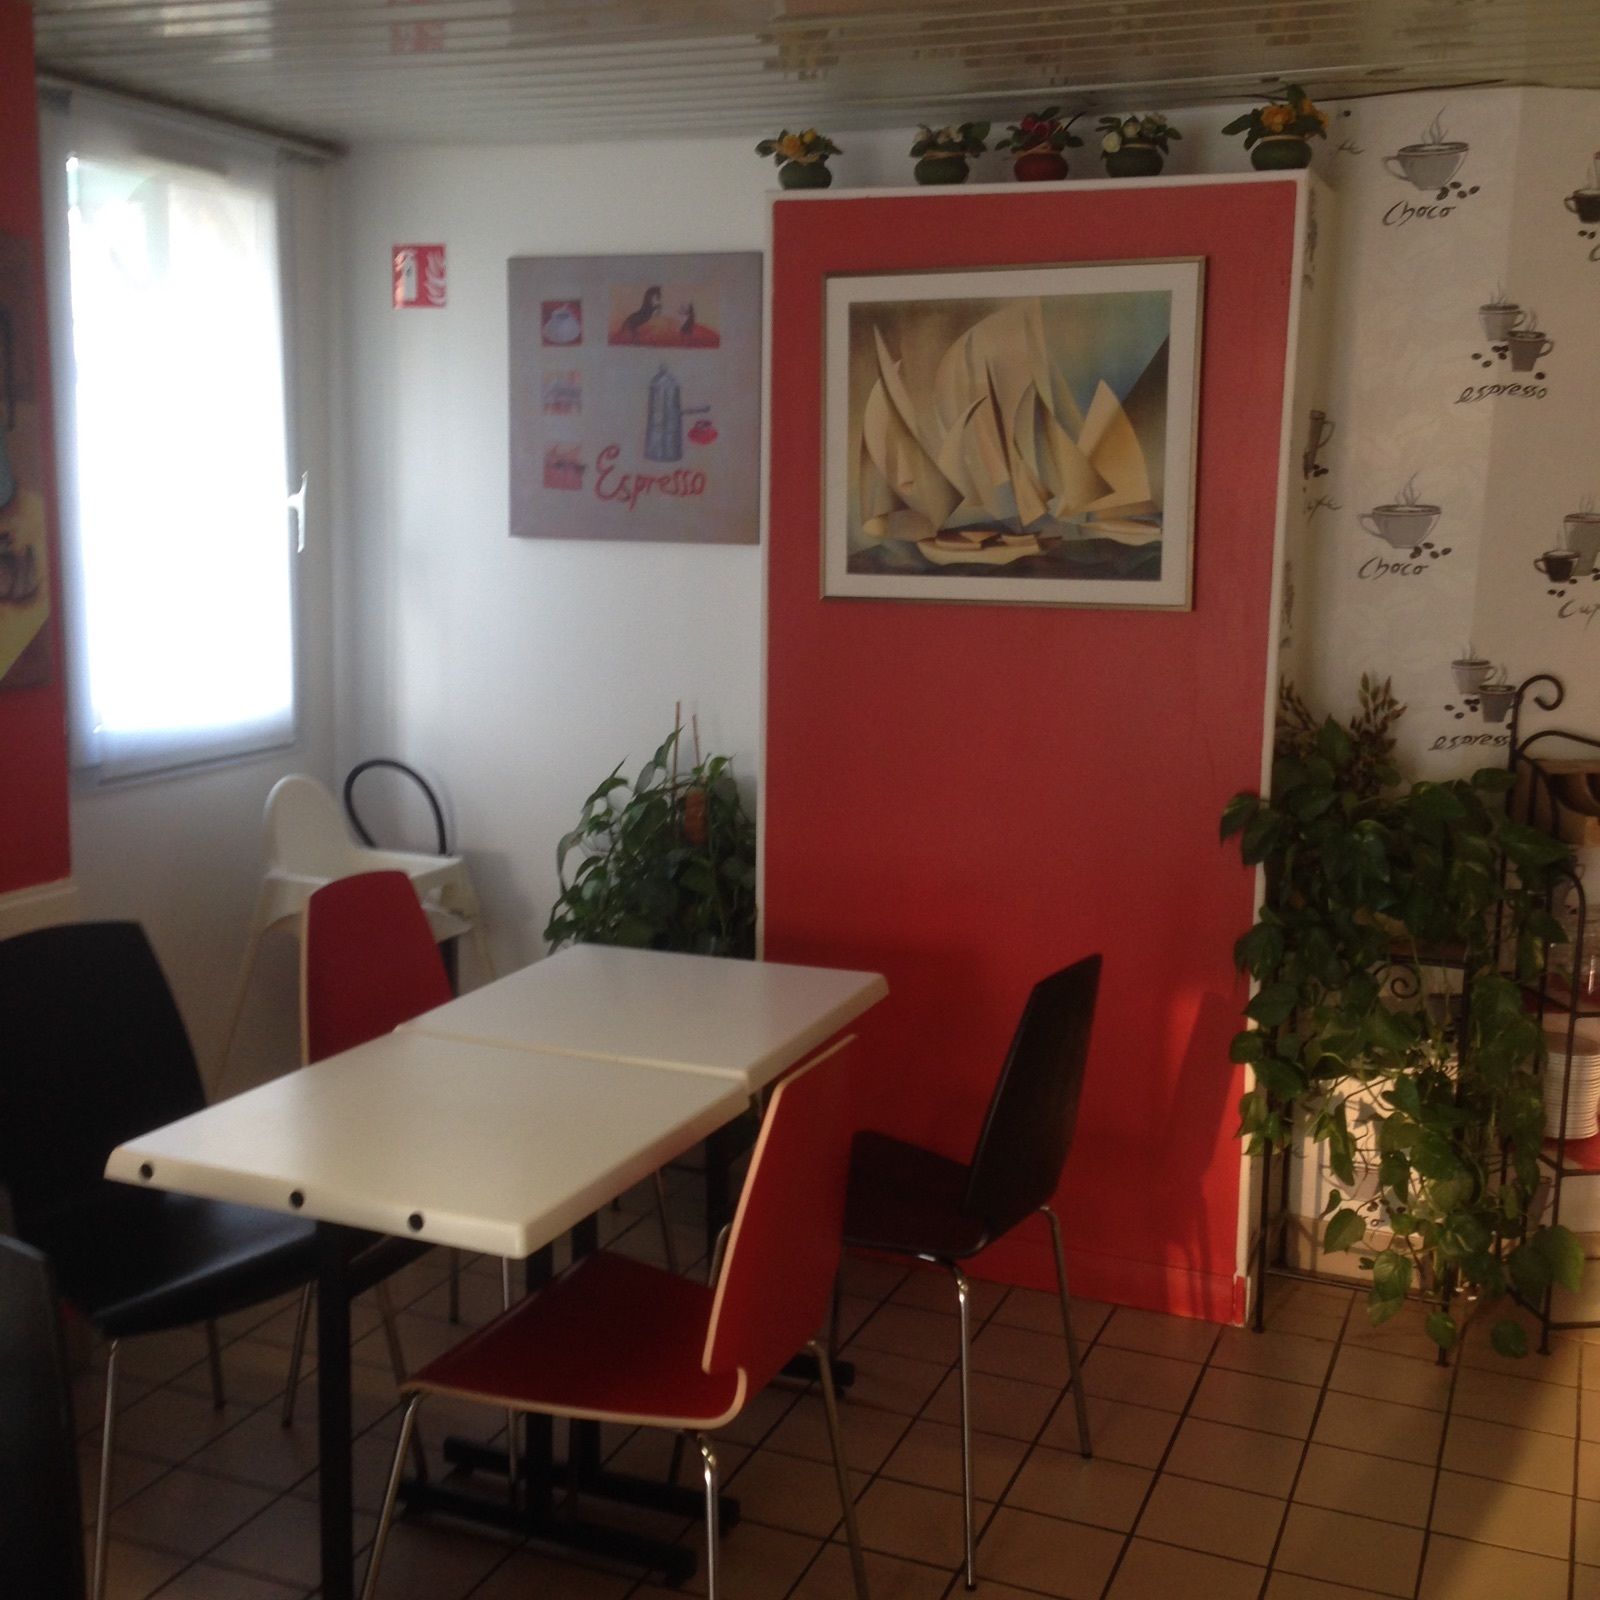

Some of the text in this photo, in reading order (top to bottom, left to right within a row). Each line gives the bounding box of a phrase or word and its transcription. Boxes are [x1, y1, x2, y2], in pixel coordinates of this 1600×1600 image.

[1382, 200, 1456, 227] Choco
[1454, 382, 1548, 404] espresso
[594, 443, 707, 511] Espresso
[1357, 555, 1429, 580] Choco
[1427, 733, 1512, 751] espress
